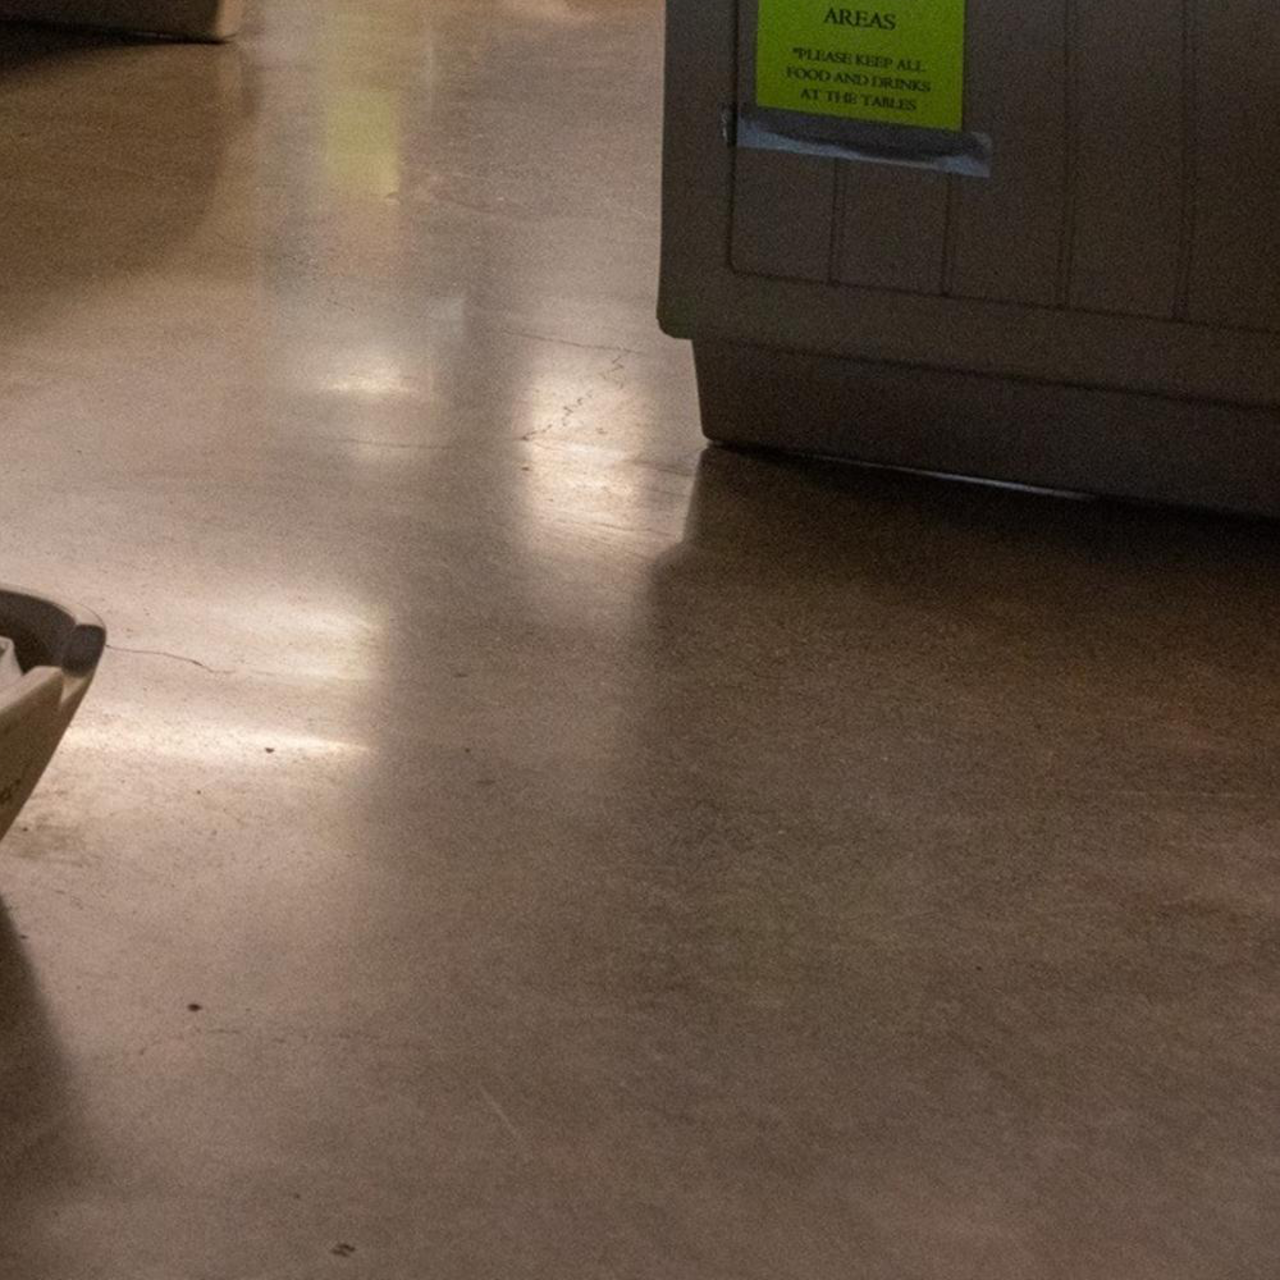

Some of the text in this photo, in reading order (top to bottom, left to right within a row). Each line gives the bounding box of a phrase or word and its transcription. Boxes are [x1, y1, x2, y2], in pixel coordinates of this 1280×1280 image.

[824, 7, 896, 31] AREAS
[855, 54, 893, 68] KEEP
[896, 59, 926, 72] ALL
[786, 66, 931, 93] FOOD AND DRINKS
[800, 88, 917, 111] AT THE TABLES
